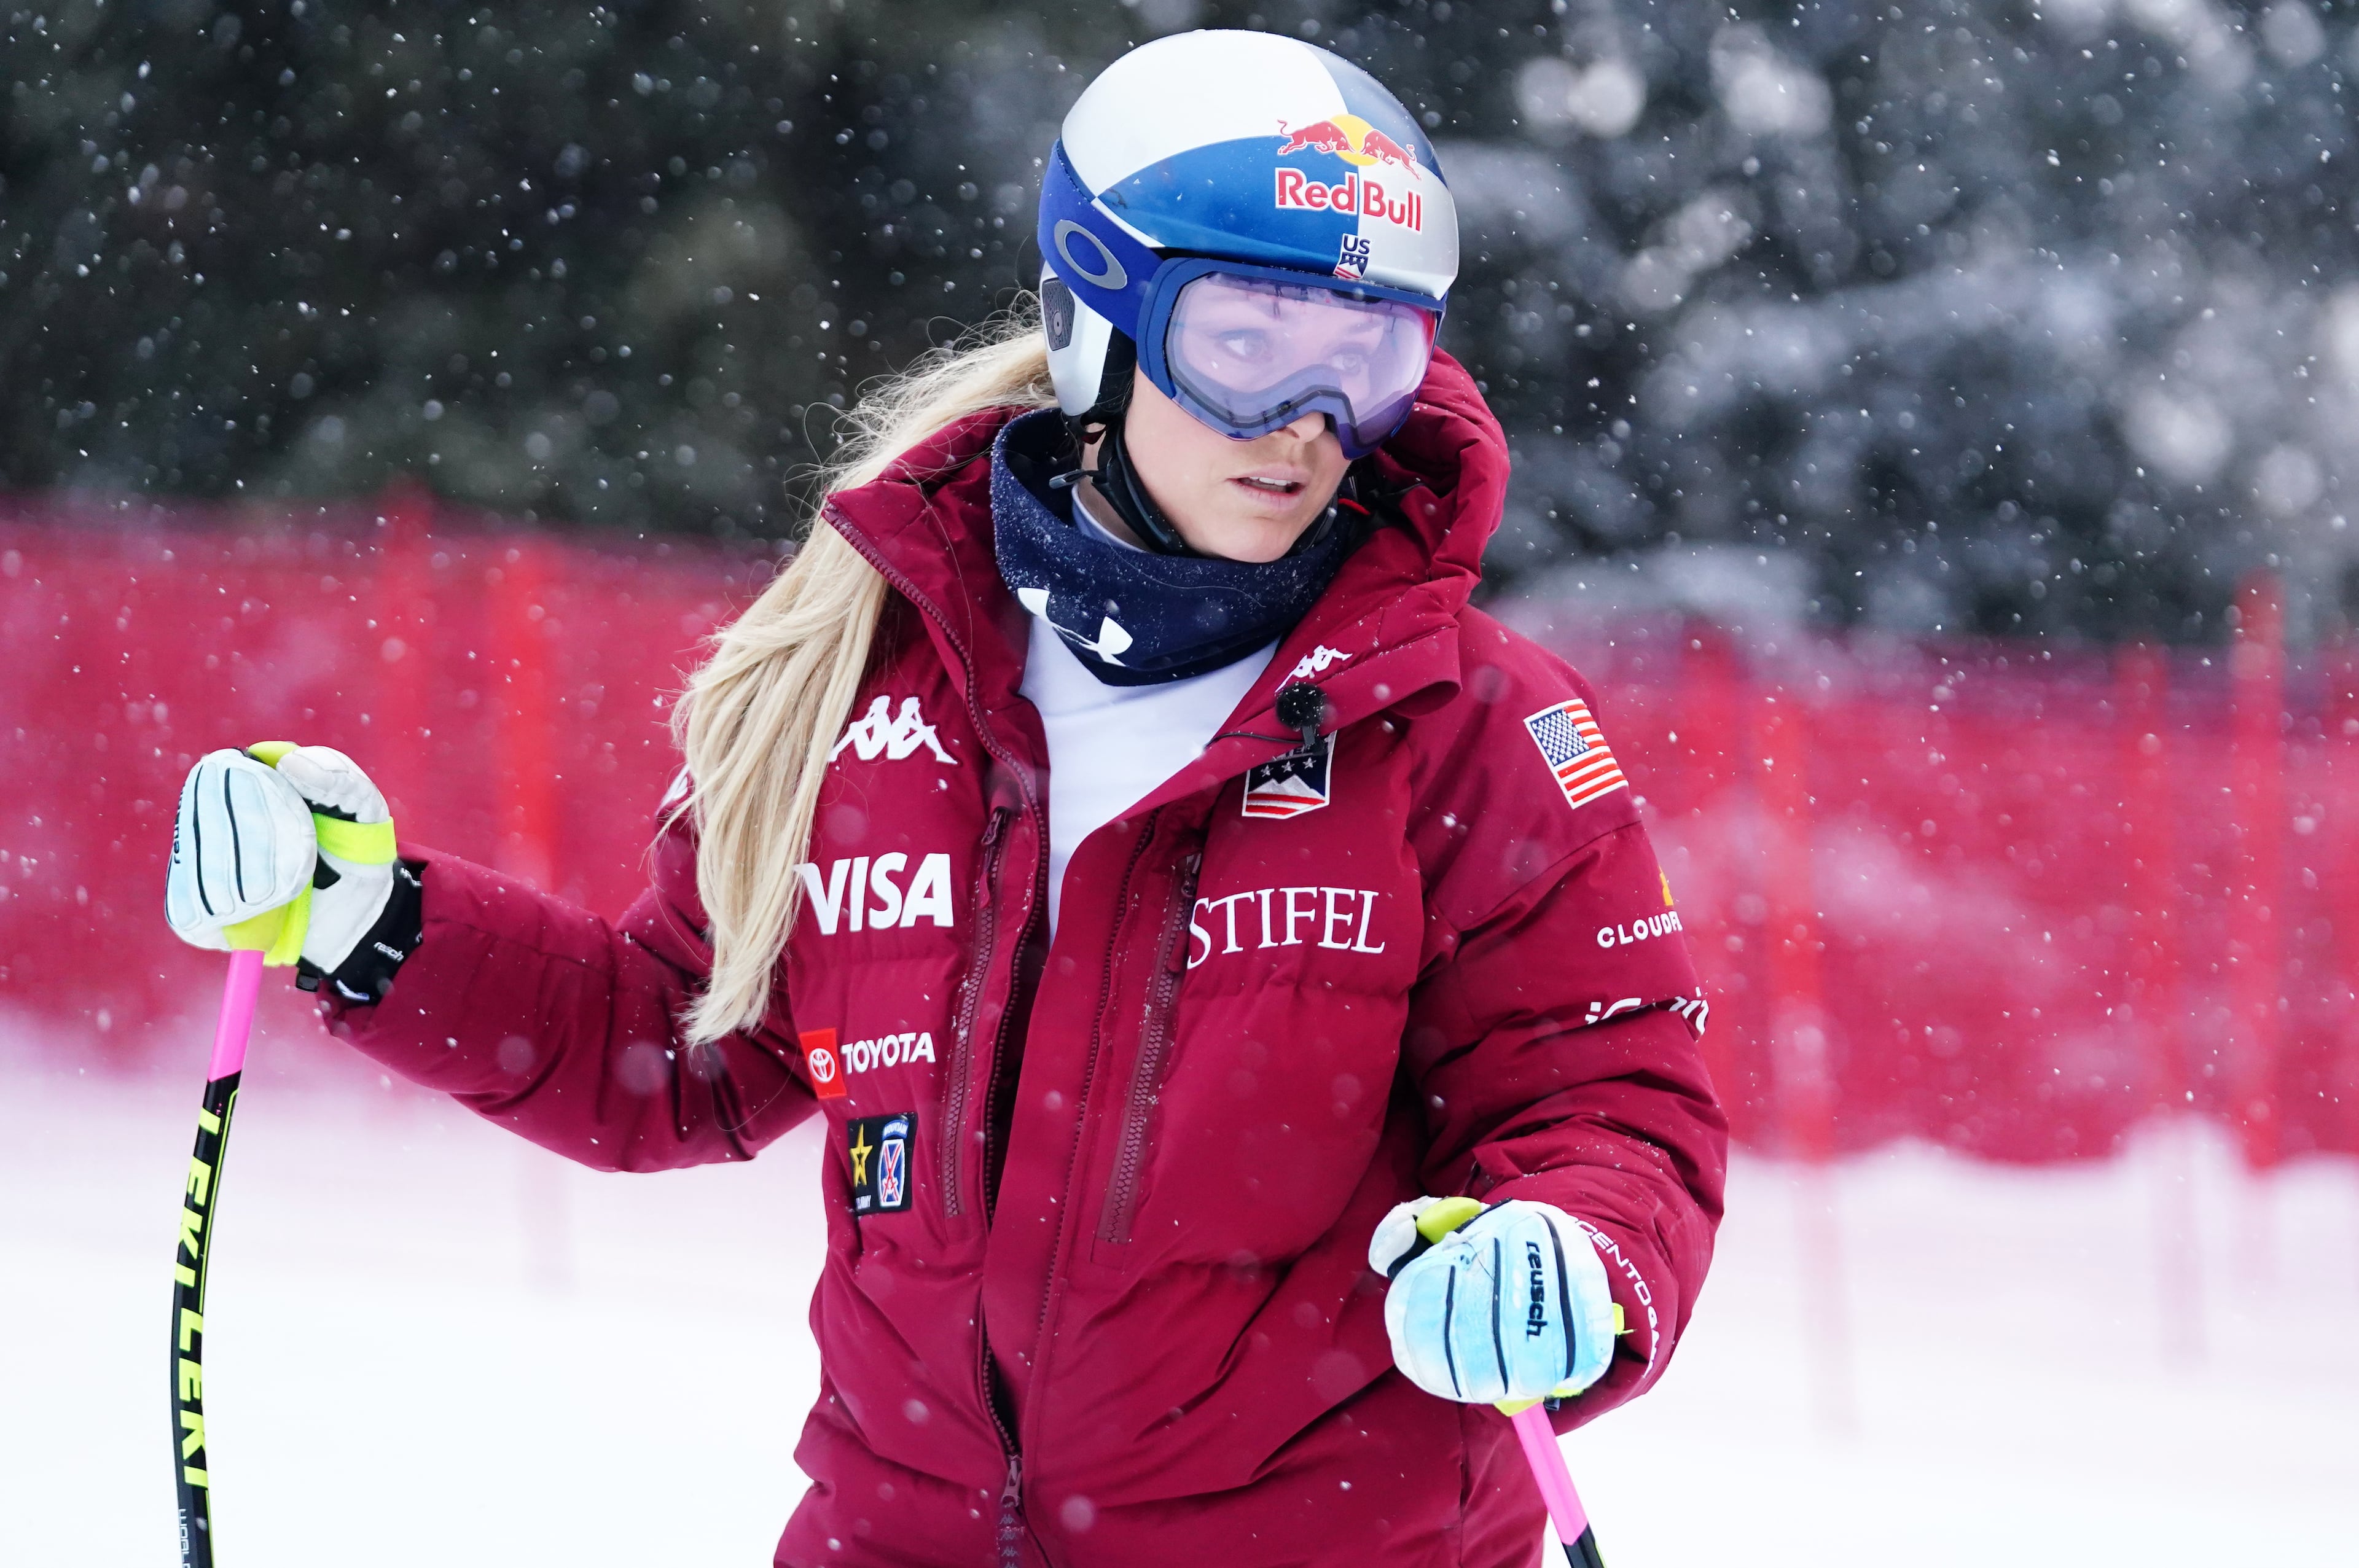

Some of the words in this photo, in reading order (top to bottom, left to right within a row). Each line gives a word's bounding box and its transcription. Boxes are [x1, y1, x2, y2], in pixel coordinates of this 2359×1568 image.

[1277, 169, 1356, 213] Red
[1362, 179, 1422, 233] Bull
[1343, 234, 1371, 255] US
[793, 852, 954, 935] VISA
[1186, 887, 1386, 970] STIFEL
[840, 1032, 936, 1074] TOYOTA
[1525, 1240, 1549, 1343] reusch
[179, 1306, 209, 1490] LEKI
